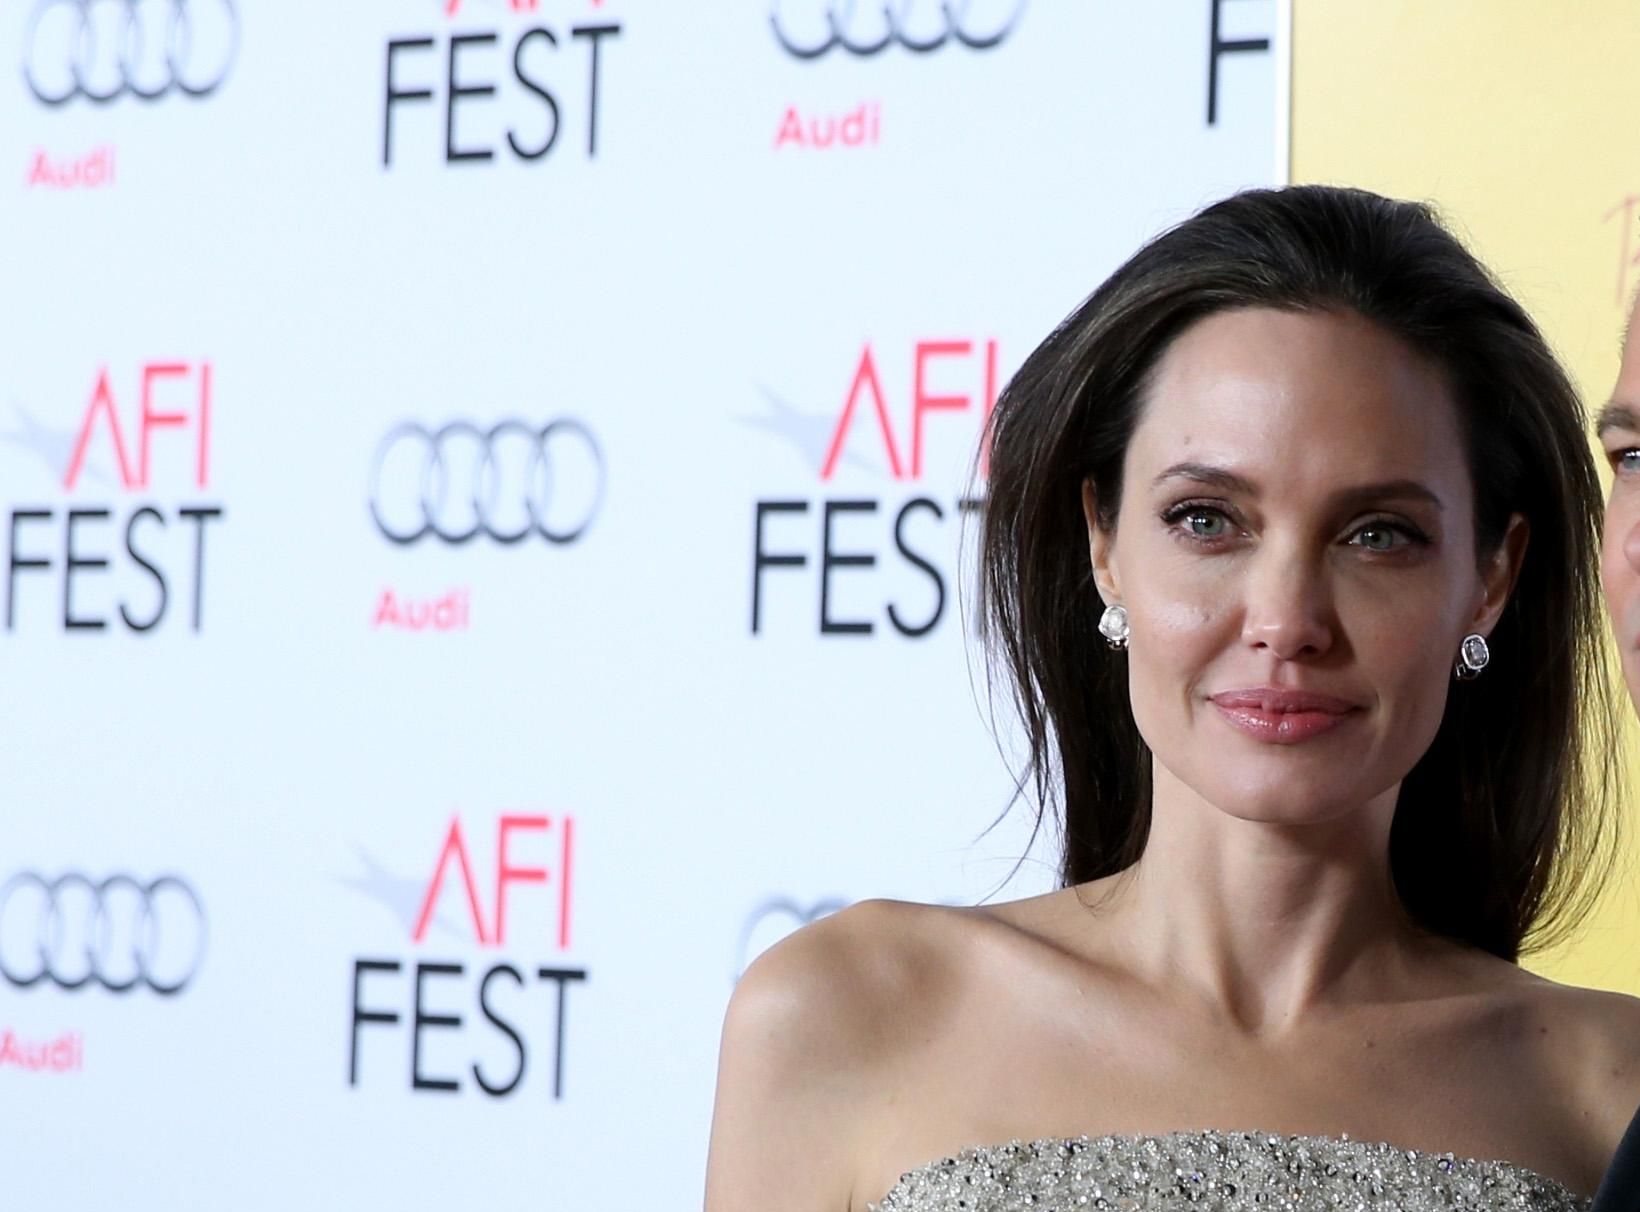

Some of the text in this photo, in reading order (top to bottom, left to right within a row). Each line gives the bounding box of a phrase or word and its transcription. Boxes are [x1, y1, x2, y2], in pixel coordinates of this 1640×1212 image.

[382, 23, 623, 168] FEST
[774, 104, 881, 149] Audi
[25, 146, 115, 189] Audi
[62, 360, 212, 491] AFI
[820, 338, 999, 481] AFI
[4, 506, 223, 635] FEST
[372, 590, 469, 632] Audi
[411, 811, 574, 950] AFI
[348, 959, 587, 1099] FEST
